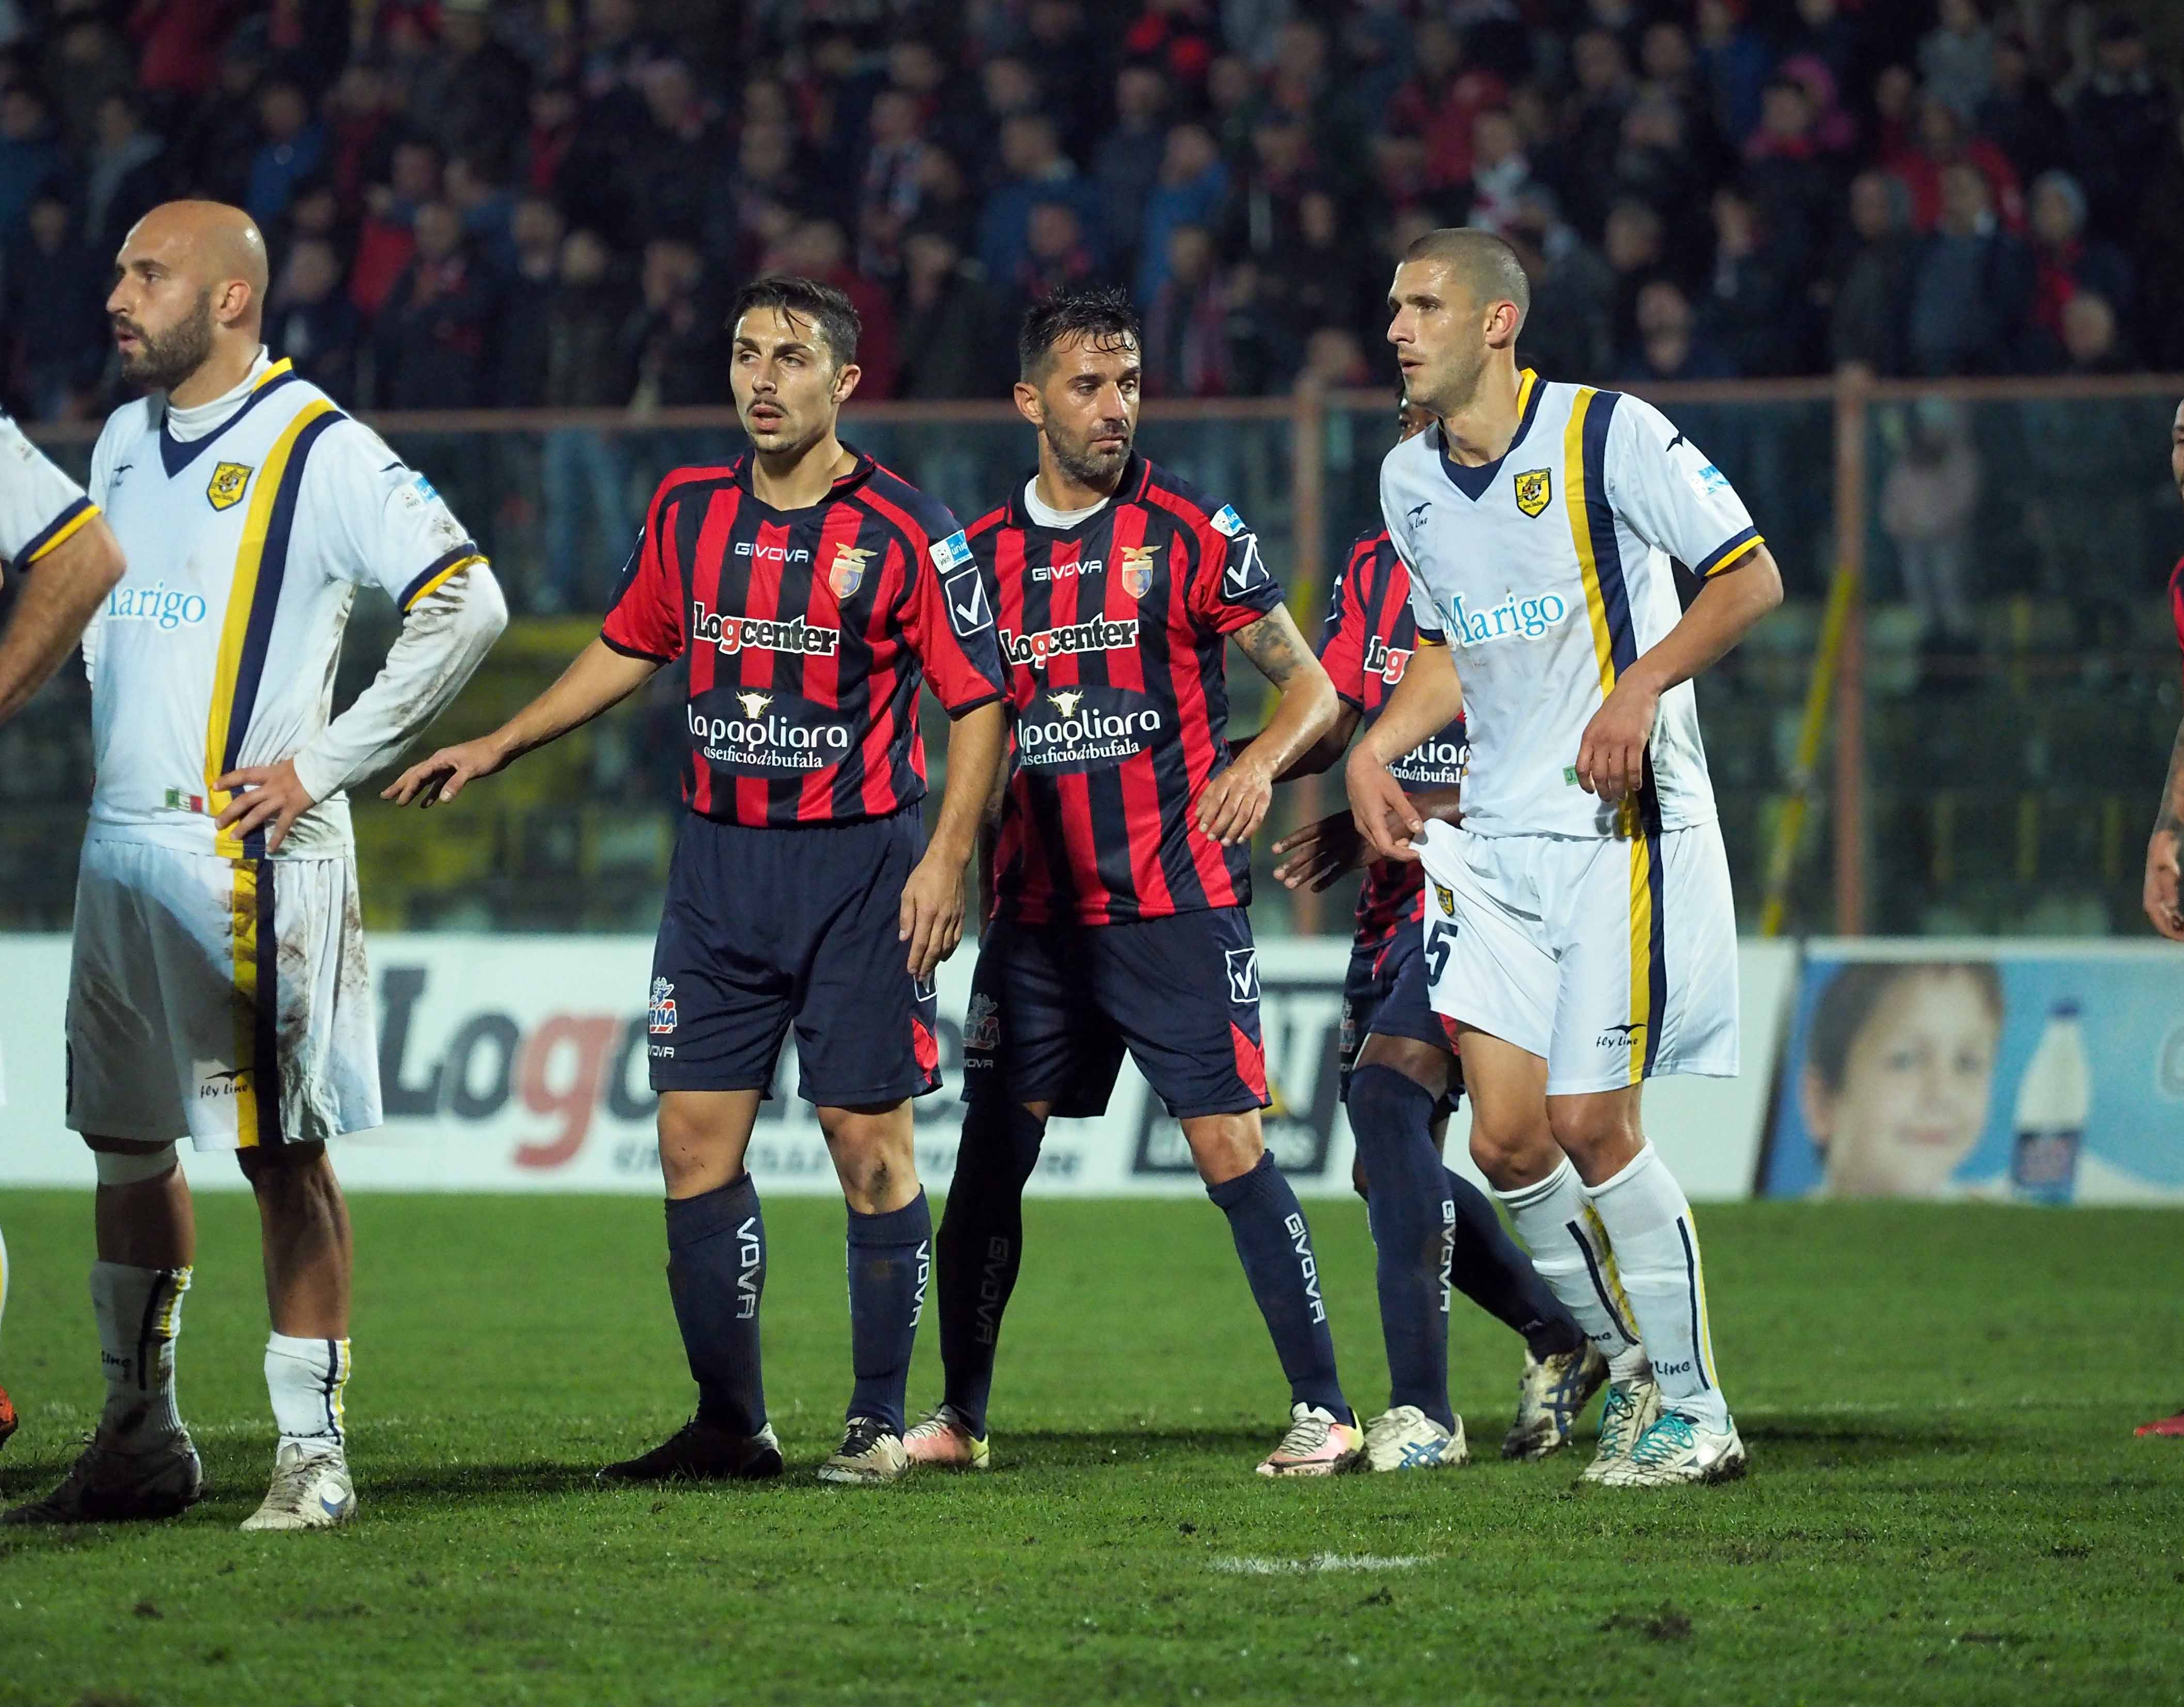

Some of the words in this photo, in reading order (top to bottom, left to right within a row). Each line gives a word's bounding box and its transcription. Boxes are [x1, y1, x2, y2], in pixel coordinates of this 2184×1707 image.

[735, 542, 809, 563] GIVOVA
[1032, 560, 1102, 582] GIVOVA
[694, 601, 839, 656] Logcenter
[999, 612, 1139, 669] Logcenter
[1436, 595, 1564, 643] Marigo
[1425, 919, 1458, 987] 5
[648, 1045, 675, 1058] VOVA
[965, 1058, 993, 1069] OVA
[736, 1216, 760, 1320] VOVA
[909, 1239, 930, 1328] VOVA
[1284, 1212, 1327, 1325] GIVOVA
[1439, 1199, 1456, 1313] GIVOVA
